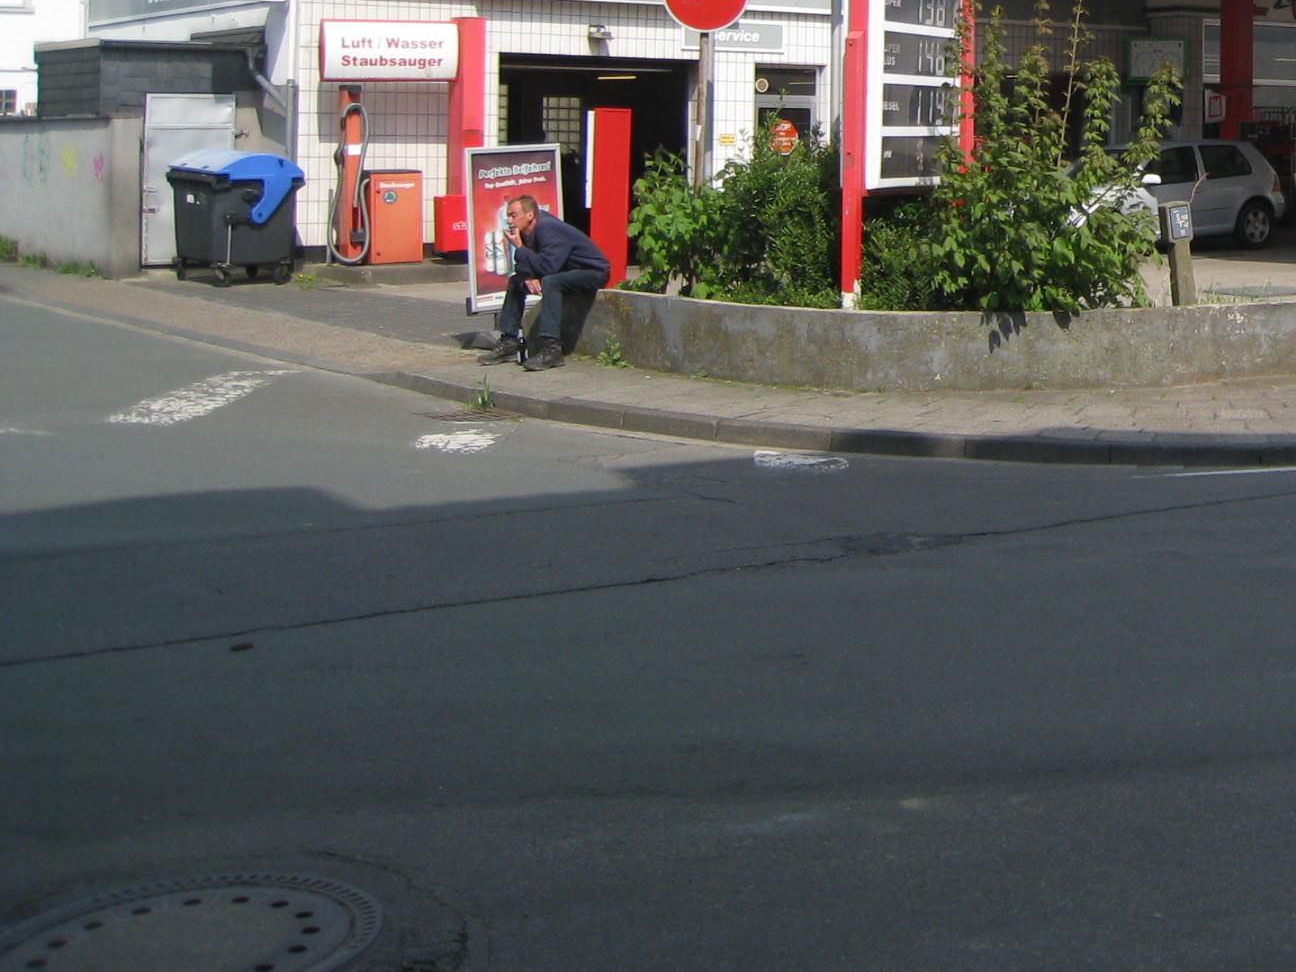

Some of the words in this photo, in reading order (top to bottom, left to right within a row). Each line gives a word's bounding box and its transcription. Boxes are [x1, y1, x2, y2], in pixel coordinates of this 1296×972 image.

[341, 36, 373, 49] Luft
[385, 37, 445, 49] Wasser
[341, 54, 445, 70] Staubsauger
